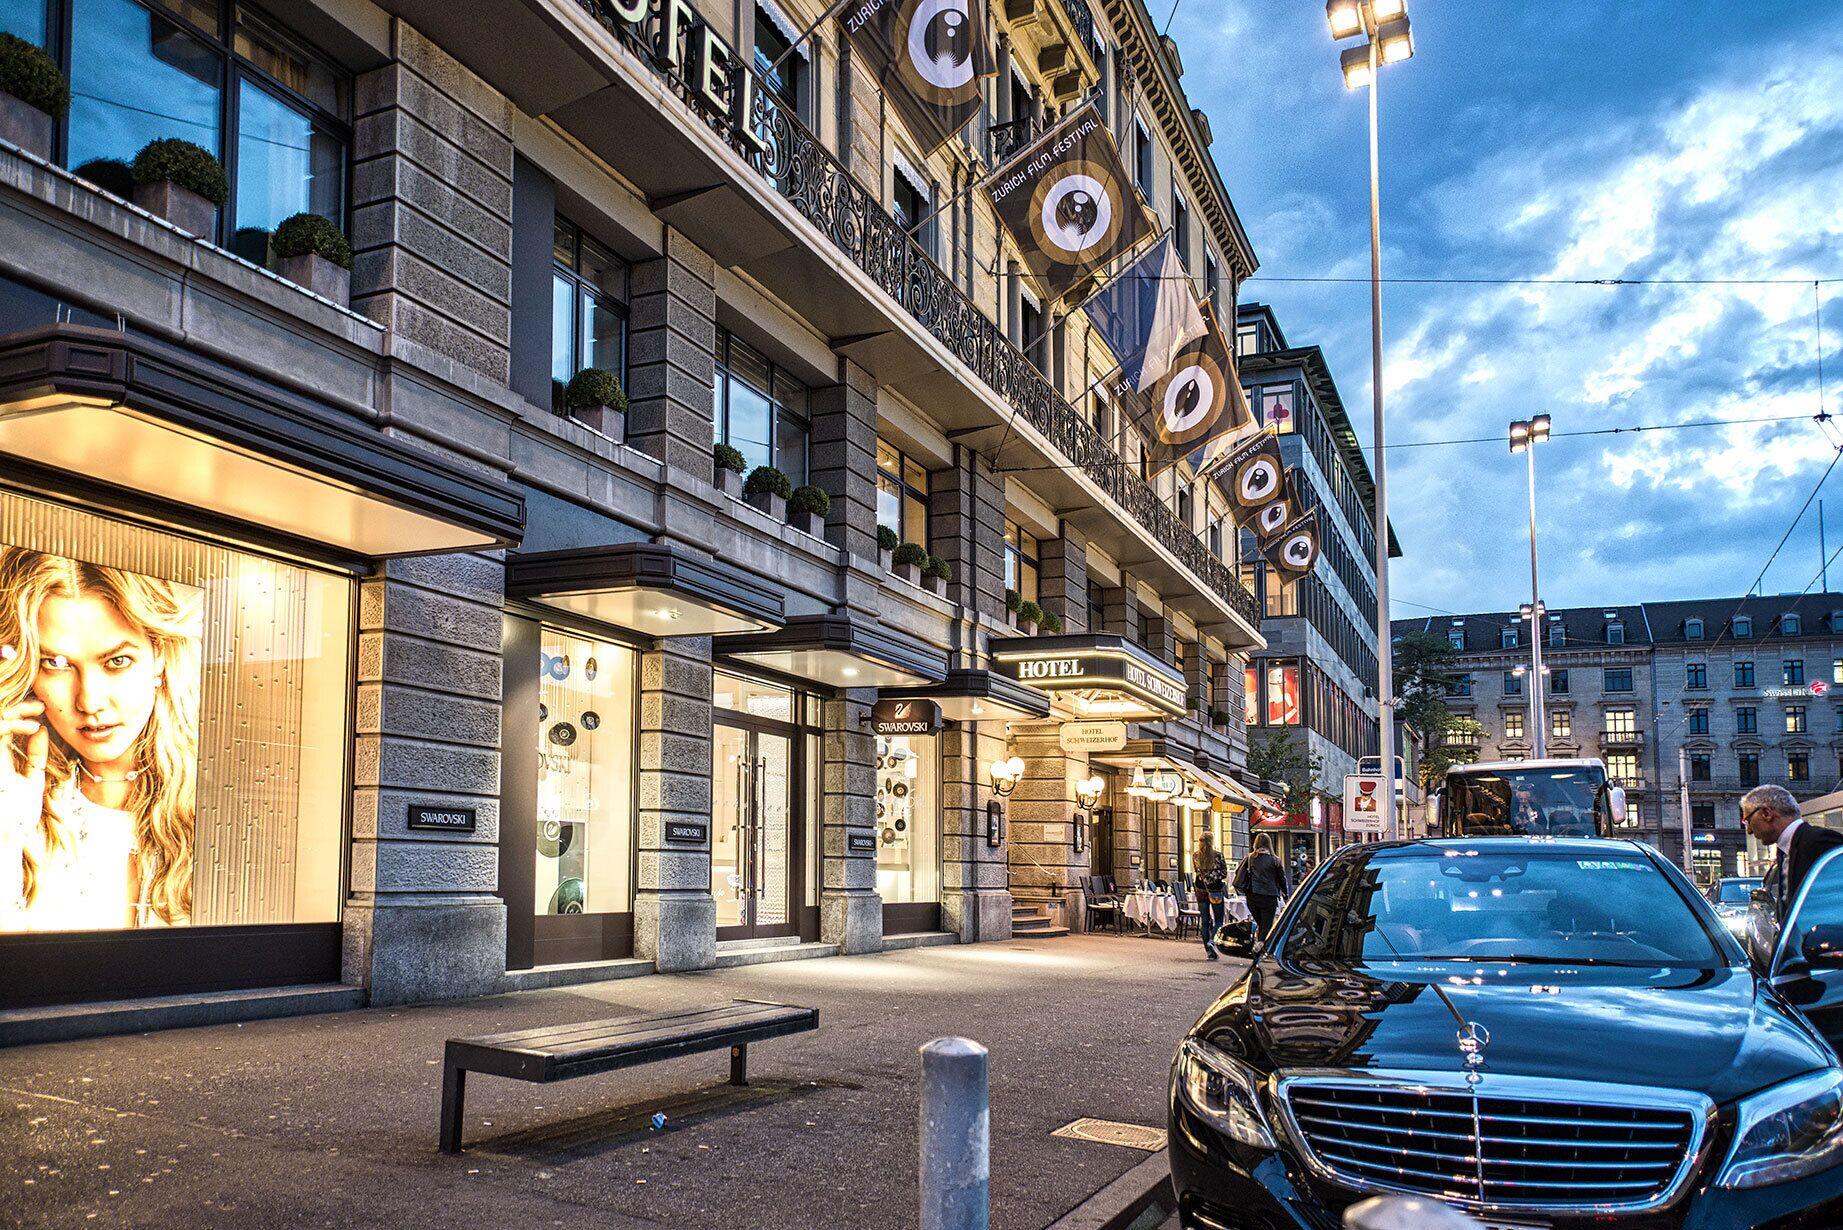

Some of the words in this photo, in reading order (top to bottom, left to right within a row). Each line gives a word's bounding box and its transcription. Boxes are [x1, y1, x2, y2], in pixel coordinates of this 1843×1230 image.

[991, 171, 1027, 203] ZURICH
[1027, 152, 1053, 176] FILM
[1052, 118, 1099, 157] FESTIVAL
[1212, 461, 1234, 480] ZURICH
[1233, 451, 1249, 464] FILM
[1018, 658, 1085, 679] HOTEL
[1127, 662, 1147, 688] HOTEL
[878, 722, 928, 732] SWAROVSKI
[1081, 728, 1104, 736] HOTEL
[1066, 736, 1119, 744] SCHWEIZERHOF
[420, 812, 466, 825] SWAROVSKI
